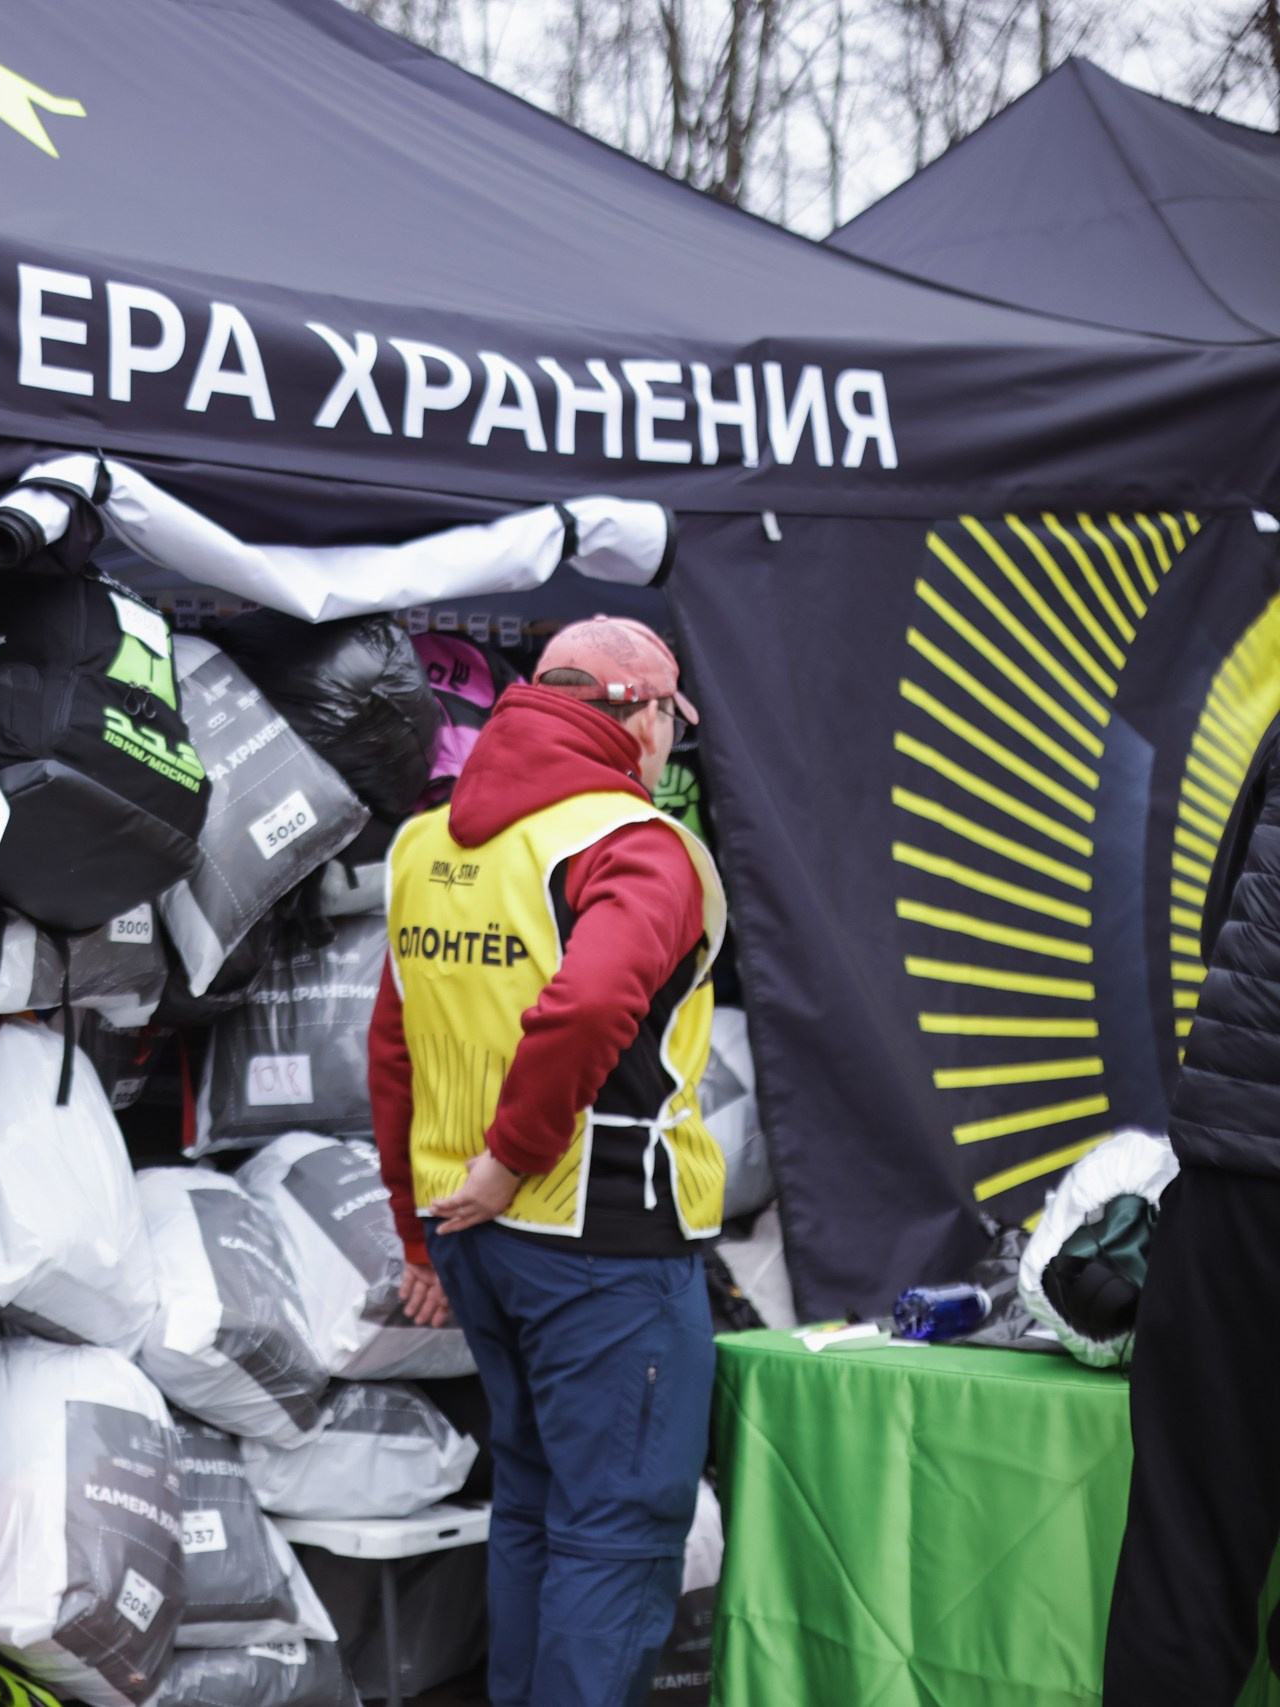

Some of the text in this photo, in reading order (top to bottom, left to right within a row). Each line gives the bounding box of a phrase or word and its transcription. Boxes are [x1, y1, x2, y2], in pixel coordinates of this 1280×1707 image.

[304, 322, 899, 469] ХРАНЕНИЯ
[265, 811, 307, 848] 3010
[117, 919, 150, 935] 3009
[399, 922, 530, 967] ОЛОНТЁР
[83, 1482, 159, 1522] КАМЕРА
[183, 1529, 215, 1545] 037
